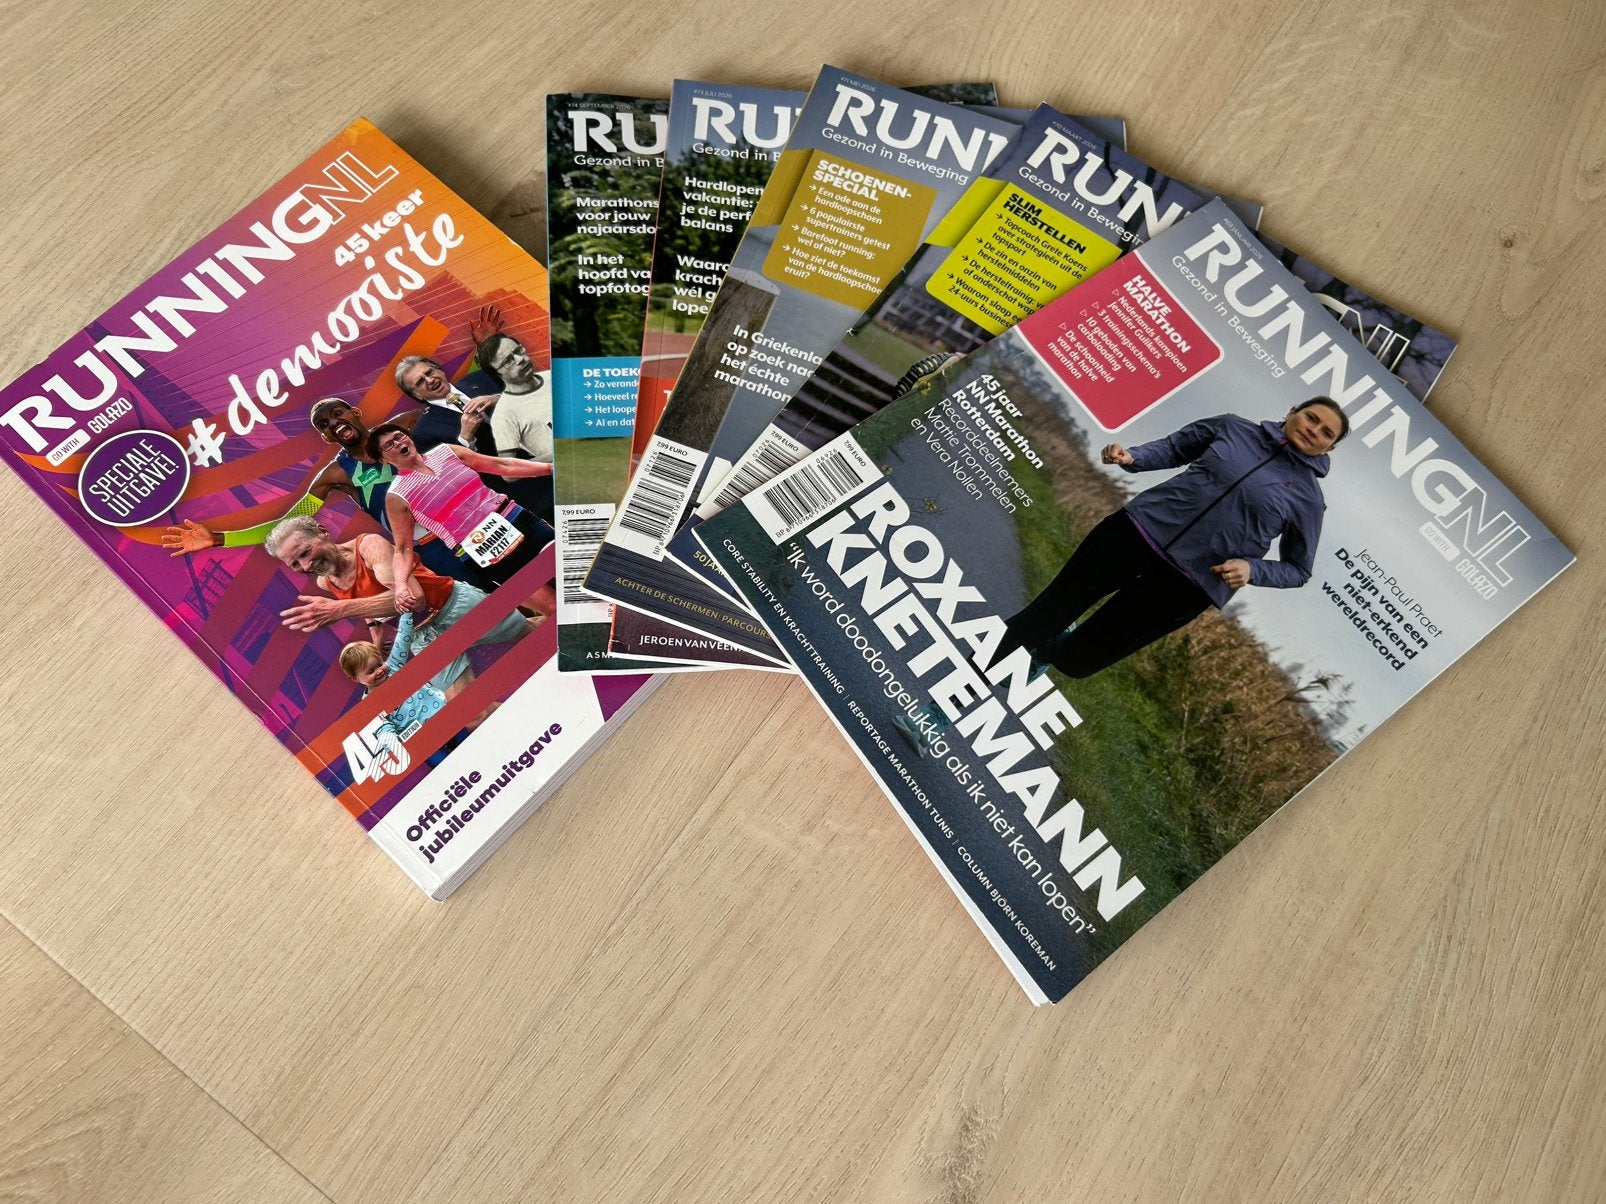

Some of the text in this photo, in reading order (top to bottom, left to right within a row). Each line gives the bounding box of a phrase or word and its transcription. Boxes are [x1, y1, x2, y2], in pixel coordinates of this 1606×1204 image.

[574, 154, 650, 167] Gezond in
[692, 142, 768, 161] Gezond in
[822, 127, 970, 187] Gezond in Beweging
[812, 170, 879, 201] SPECIAL
[817, 159, 912, 199] SCHOENEN-
[1019, 166, 1085, 212] Gezond in
[1026, 126, 1193, 240] RUN
[576, 210, 651, 224] voor jouw
[680, 203, 717, 217] je de
[814, 195, 883, 225] hardloopschoen
[818, 187, 881, 215] Een ode aan de
[1008, 193, 1043, 217] SLIM
[334, 188, 426, 268] 45 keer
[680, 217, 733, 233] balans
[800, 226, 839, 246] Barefoot
[805, 216, 891, 251] supertrainers getest
[815, 209, 866, 233] populairste
[997, 225, 1016, 239] over
[1003, 200, 1087, 255] HERSTELLEN
[578, 254, 624, 265] In het
[797, 235, 824, 251] wel of
[991, 231, 1027, 257] topsport
[1003, 217, 1089, 273] Topcoach Grete Koens
[578, 268, 628, 280] hoofd
[784, 265, 811, 279] eruit?
[788, 256, 818, 272] van de
[791, 247, 881, 284] Hoe ziet de toekomst
[969, 259, 982, 271] De
[977, 249, 1041, 292] herstelmiddelen
[983, 241, 1058, 291] De zin en onzin van
[673, 284, 703, 299] wél
[948, 285, 979, 308] 24-uurs
[955, 276, 1013, 318] Waarom slaap
[963, 267, 1018, 305] of onderschat
[1131, 274, 1172, 316] HALVE
[733, 324, 749, 339] In
[1107, 301, 1162, 360] Jennifer Gulikers
[1117, 296, 1188, 374] Nederlands kampioen
[1123, 280, 1192, 354] MARATHON
[1172, 255, 1286, 379] Gezond in Beweging
[727, 340, 785, 368] op zoek
[1047, 342, 1083, 379] marathon
[1056, 336, 1099, 382] van halve
[1074, 340, 1116, 384] schoonheid
[1077, 323, 1122, 372] carboloading
[1093, 326, 1137, 373] geboden van
[583, 368, 600, 378] DE
[594, 380, 606, 388] Zo
[720, 353, 790, 387] het échte
[594, 392, 630, 401] Hoeveel
[594, 405, 611, 414] Het
[980, 373, 1023, 419] 45 jaar
[951, 389, 1016, 462] Rotterdam
[965, 380, 1044, 470] NN Marathon
[51, 437, 80, 462] GO WITH
[910, 417, 984, 501] en Vera Nollen
[924, 406, 1017, 514] Mattie Trommelen
[937, 398, 1034, 508] Recorddeelnemers
[88, 438, 161, 503] SPECIALE
[106, 453, 181, 517] UITGAVE!
[474, 524, 508, 557] MARIAN
[482, 518, 497, 533] NN
[693, 549, 707, 563] 50
[615, 576, 721, 622] ACHTER DE SCHERMEN:
[1334, 547, 1429, 650] De pijn van een
[1353, 548, 1443, 639] Jean-Paul Praet
[849, 481, 1084, 751] ROXANE
[1321, 580, 1406, 672] wereldrecord
[1342, 582, 1419, 661] niet-erkend
[639, 634, 683, 648] JEROEN
[401, 720, 421, 740] EDITION
[801, 565, 845, 614] word
[836, 613, 950, 759] doodongelukkig
[946, 755, 973, 786] als
[966, 780, 986, 804] ik
[980, 799, 1016, 840] niet
[1008, 834, 1042, 878] kan
[805, 510, 1146, 922] KNETEMANN
[722, 538, 1057, 971] CORE STABILITY EN KRACHTTRAINING REPORTAGE MARATHON TUNIS COLUMN BJÖRN KOREMAN
[405, 767, 482, 844] Officiële
[418, 719, 563, 863] jubileumuitgave
